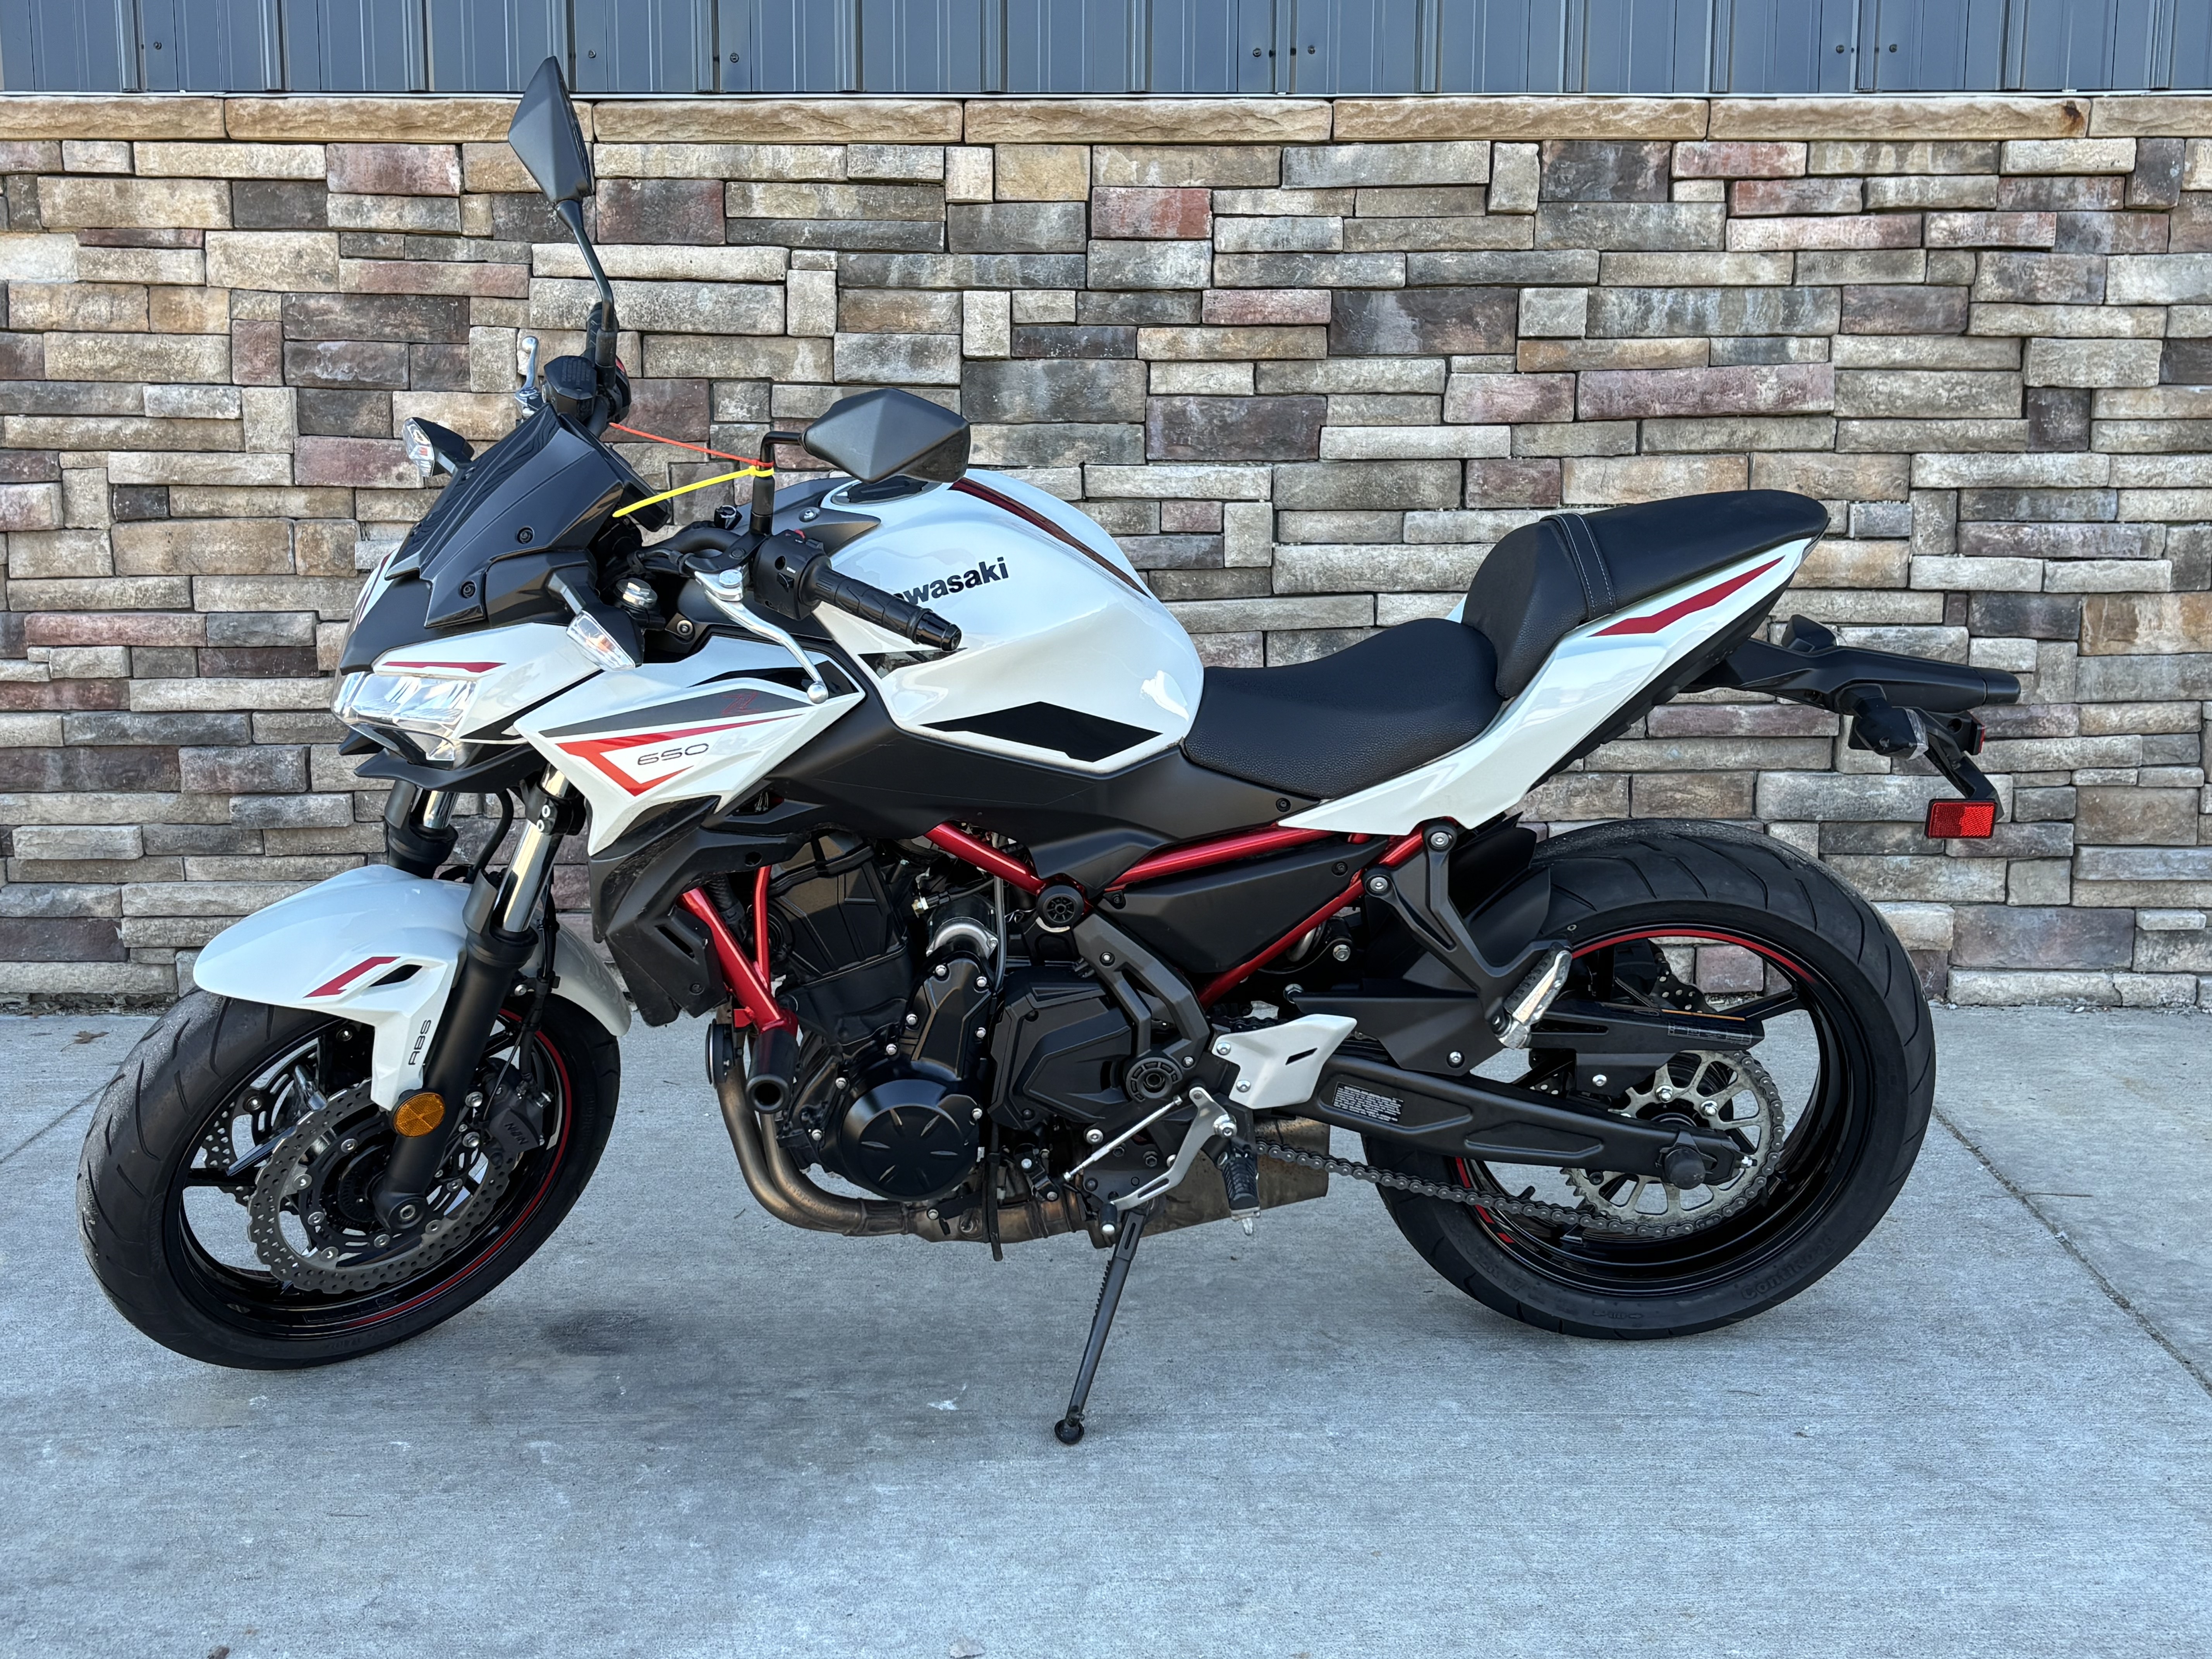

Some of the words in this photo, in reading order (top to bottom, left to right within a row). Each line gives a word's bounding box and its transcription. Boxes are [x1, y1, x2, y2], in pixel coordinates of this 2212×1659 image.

[893, 556, 1009, 605] wasaki
[637, 743, 709, 765] 650
[408, 1020, 431, 1065] ABS
